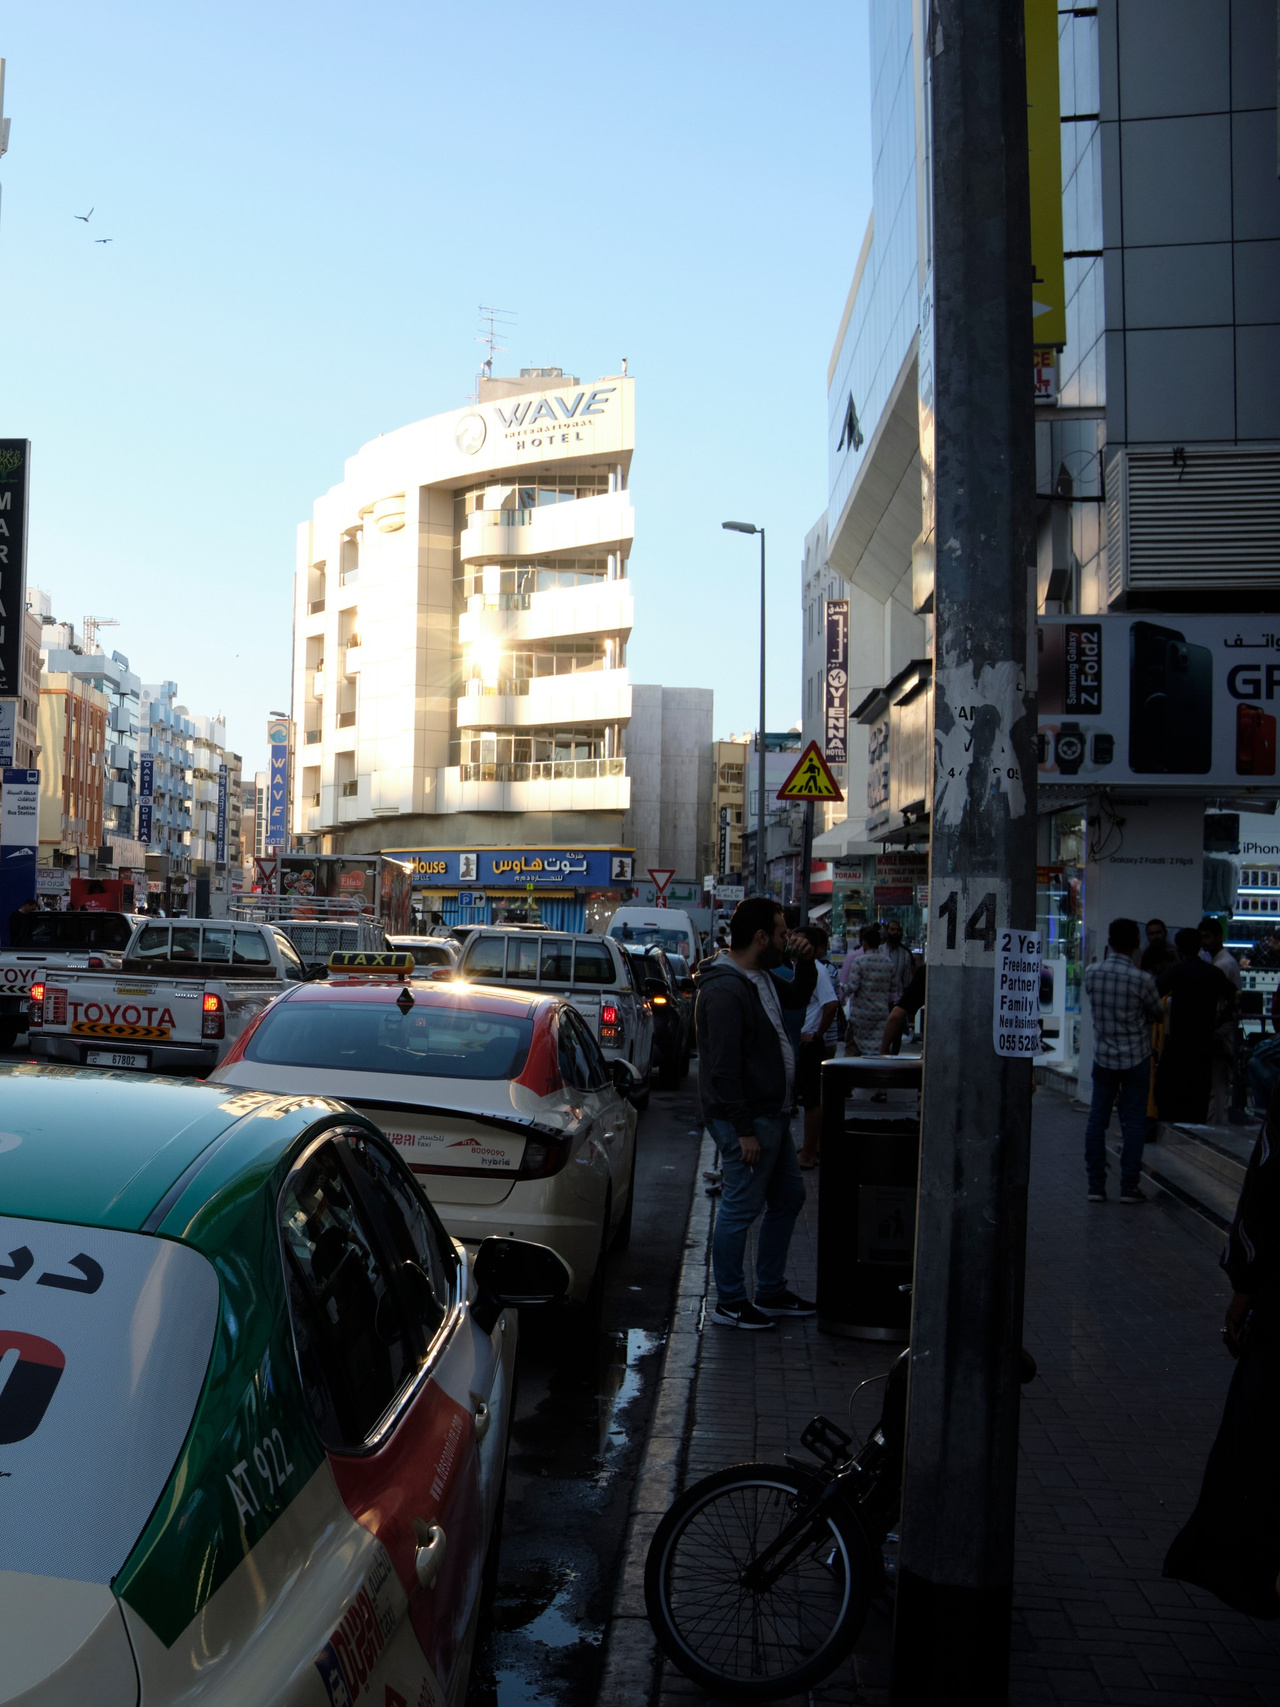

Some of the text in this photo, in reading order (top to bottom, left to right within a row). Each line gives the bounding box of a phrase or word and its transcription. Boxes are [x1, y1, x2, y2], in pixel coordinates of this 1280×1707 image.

[494, 387, 616, 429] WAVE
[517, 432, 584, 450] HOTEL
[1067, 631, 1079, 705] Samsung Galaxy
[1081, 631, 1099, 707] Z Fold2
[828, 687, 845, 748] VIENNA
[143, 761, 151, 795] OASIS
[272, 758, 286, 816] WAVE
[141, 807, 149, 840] DEIRA
[410, 857, 446, 873] House
[493, 856, 587, 875] بوت هاوس
[1110, 856, 1137, 865] Galaxy
[939, 892, 997, 952] 14
[1001, 933, 1012, 952] 2
[342, 954, 399, 966] TAXI
[1001, 974, 1036, 992] Partner
[69, 1002, 176, 1028] TOYOTA
[1001, 995, 1034, 1016] Family
[999, 1014, 1013, 1028] New
[999, 1034, 1016, 1051] 055
[112, 1055, 136, 1066] 67802
[471, 1147, 505, 1157] 8009090
[481, 1157, 510, 1166] hybrid
[225, 1428, 295, 1526] AT 922
[377, 1604, 397, 1639] taxi
